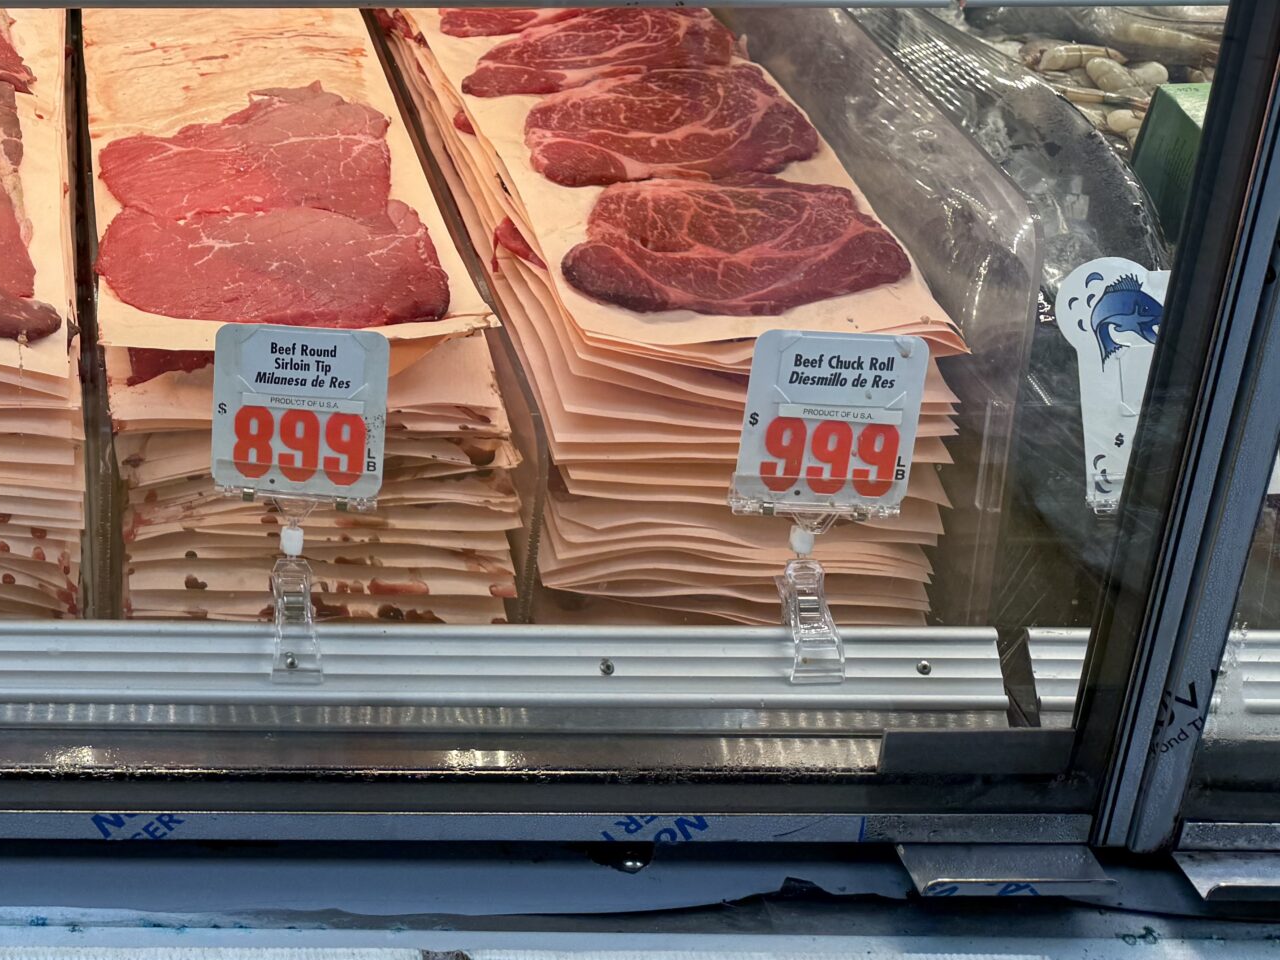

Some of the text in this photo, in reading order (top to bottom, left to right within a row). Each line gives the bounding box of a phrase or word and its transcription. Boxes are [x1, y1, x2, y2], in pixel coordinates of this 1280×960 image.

[271, 342, 336, 358] Beef Round
[275, 358, 331, 375] Sirloin Tip
[794, 354, 894, 371] Beef Chuck Roll
[255, 372, 350, 388] Milanesa de Res
[789, 372, 895, 388] Diesmillo de Res
[218, 403, 227, 415] $
[270, 397, 305, 405] PRODUCT
[749, 412, 759, 427] $
[803, 409, 839, 417] PRODUCT
[1114, 432, 1125, 448] $
